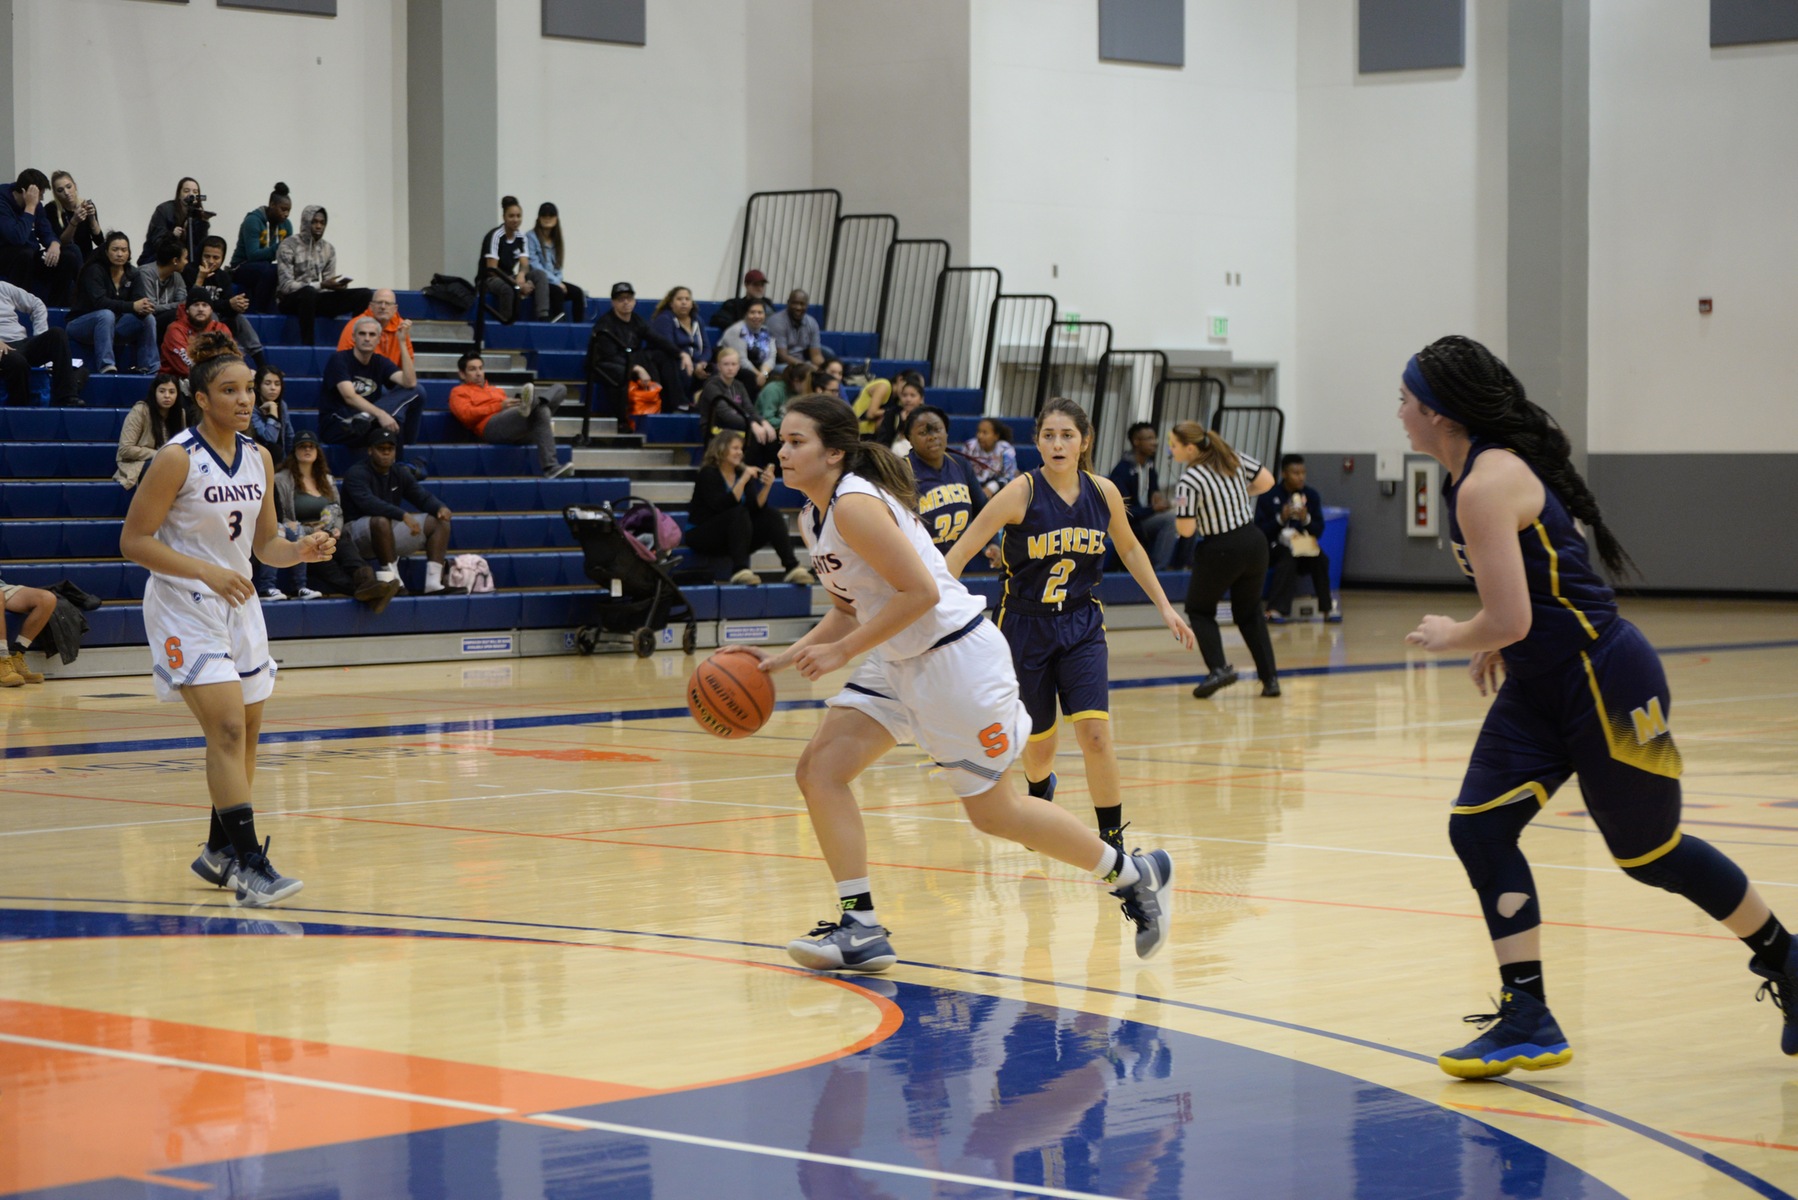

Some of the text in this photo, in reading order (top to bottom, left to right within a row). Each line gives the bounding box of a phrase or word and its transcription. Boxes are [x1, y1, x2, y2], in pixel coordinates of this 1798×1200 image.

[204, 484, 262, 503] GIANTS
[228, 510, 243, 541] 3
[932, 510, 969, 543] 32
[1041, 558, 1076, 603] 2
[164, 636, 184, 669] S
[1630, 696, 1669, 745] M
[977, 722, 1008, 758] S
